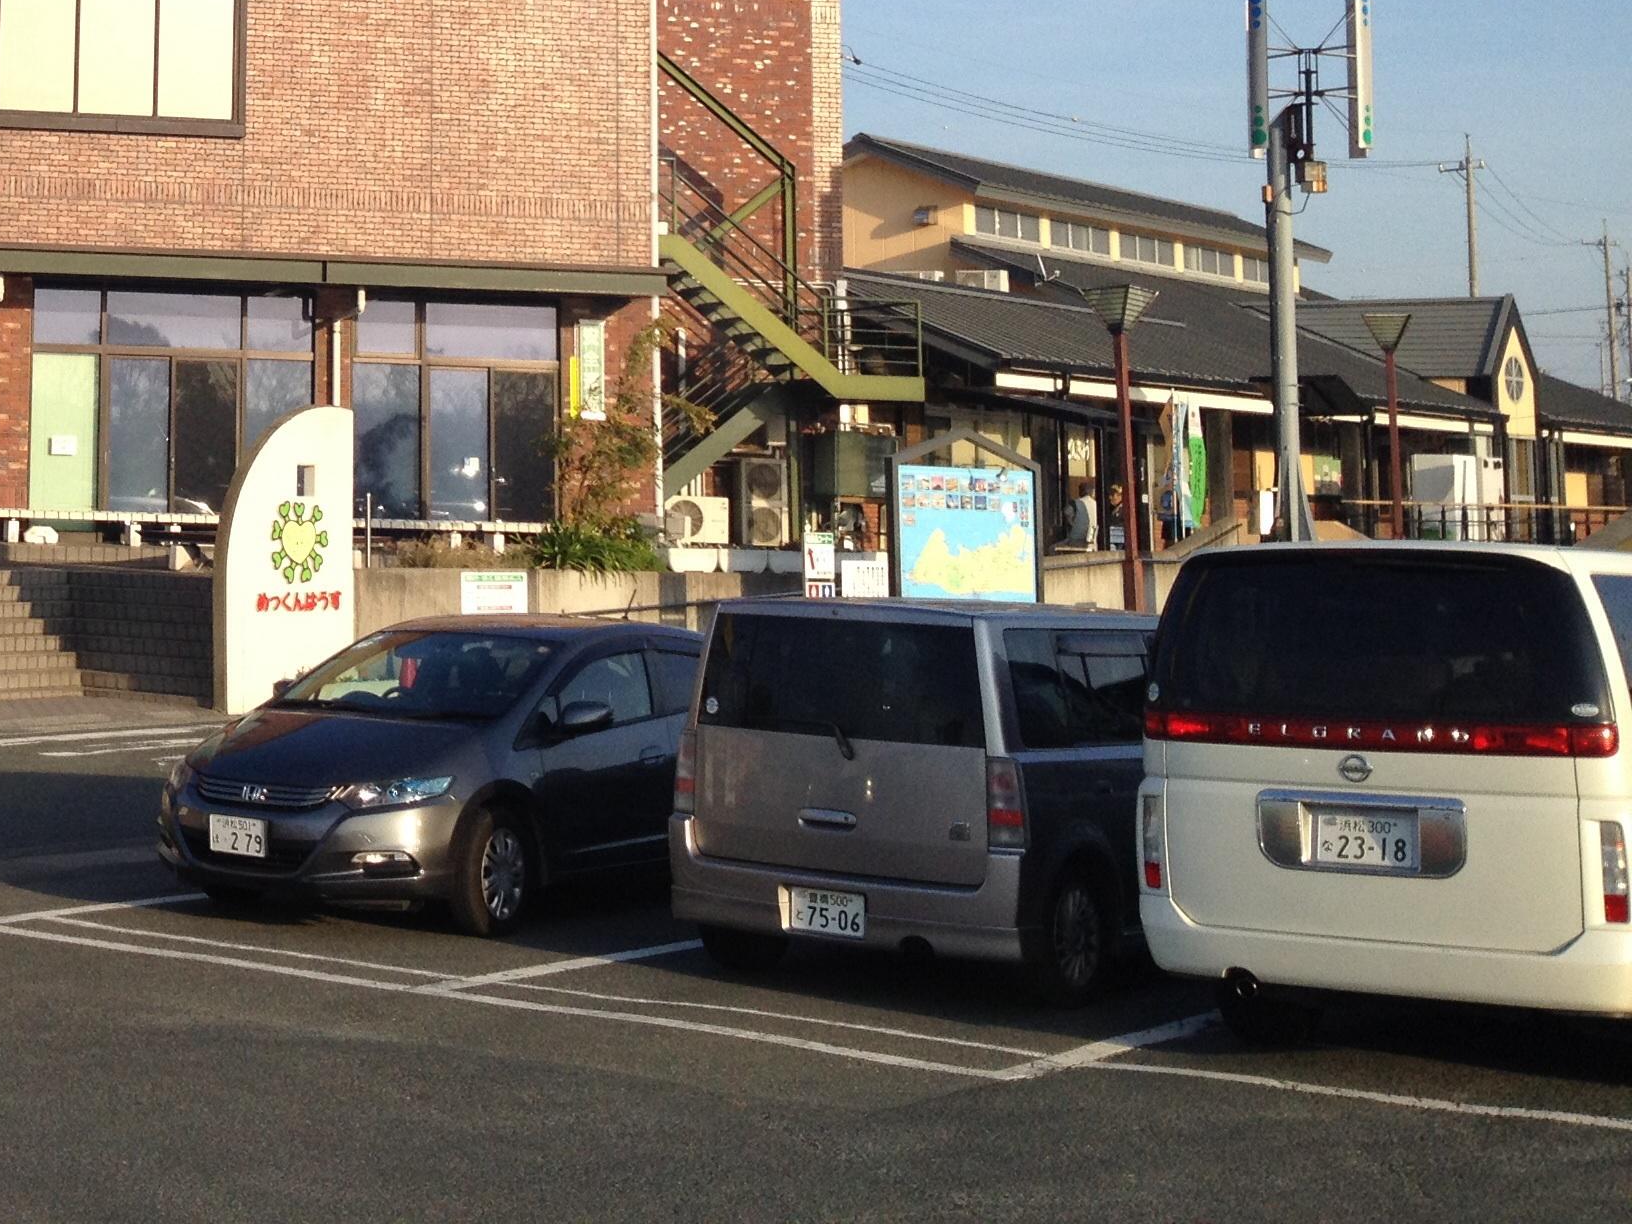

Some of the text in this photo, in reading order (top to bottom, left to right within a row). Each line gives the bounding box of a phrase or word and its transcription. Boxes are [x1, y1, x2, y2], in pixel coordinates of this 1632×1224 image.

[1248, 722, 1470, 744] ELGRAND
[1336, 834, 1407, 863] 23-18
[807, 905, 861, 933] 75-06
